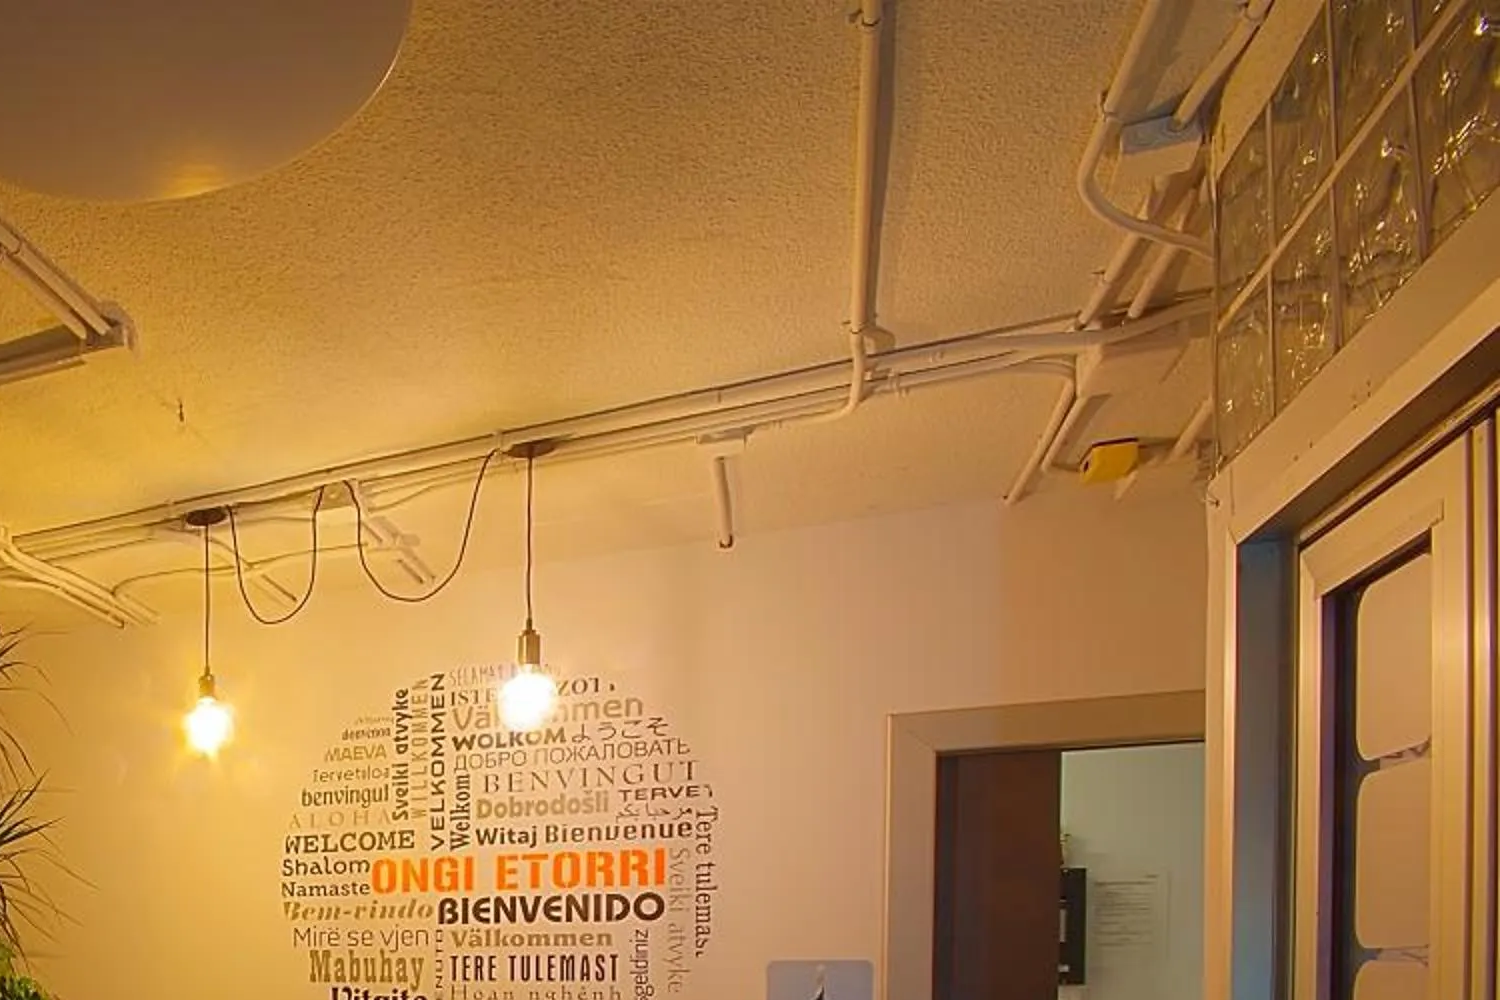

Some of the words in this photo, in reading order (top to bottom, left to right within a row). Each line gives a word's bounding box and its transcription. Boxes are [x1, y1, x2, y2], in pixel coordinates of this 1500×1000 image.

[451, 687, 498, 706] ISTE
[392, 688, 412, 754] atvyke
[451, 697, 643, 730] Välmen
[452, 727, 566, 750] WOLKOM
[572, 717, 668, 743] ようこそ
[324, 744, 387, 762] MAEVA
[430, 673, 445, 850] VELKOMMEN
[454, 751, 527, 771] ДОБРО
[534, 738, 690, 764] ПОЖАЛОВАТЬ
[484, 760, 699, 793] BENVINGUT
[392, 763, 409, 820] Sveiki
[476, 789, 609, 819] Dobrodošli
[450, 774, 470, 850] Welkom
[285, 830, 415, 854] WELCOME
[476, 826, 537, 848] Witaj
[695, 805, 718, 855] Tere
[282, 856, 371, 876] Shalom
[371, 855, 475, 895] ONGI
[495, 848, 667, 893] ETORRI
[281, 881, 371, 897] Namaste
[438, 892, 665, 925] BIENVENIDO
[347, 930, 373, 948] se
[379, 923, 429, 952] vjen
[451, 928, 613, 948] Välkommen
[309, 949, 424, 991] Mabuhay
[450, 954, 497, 982] TERE
[508, 954, 619, 982] TULEMAST
[451, 984, 515, 1000] Hoan
